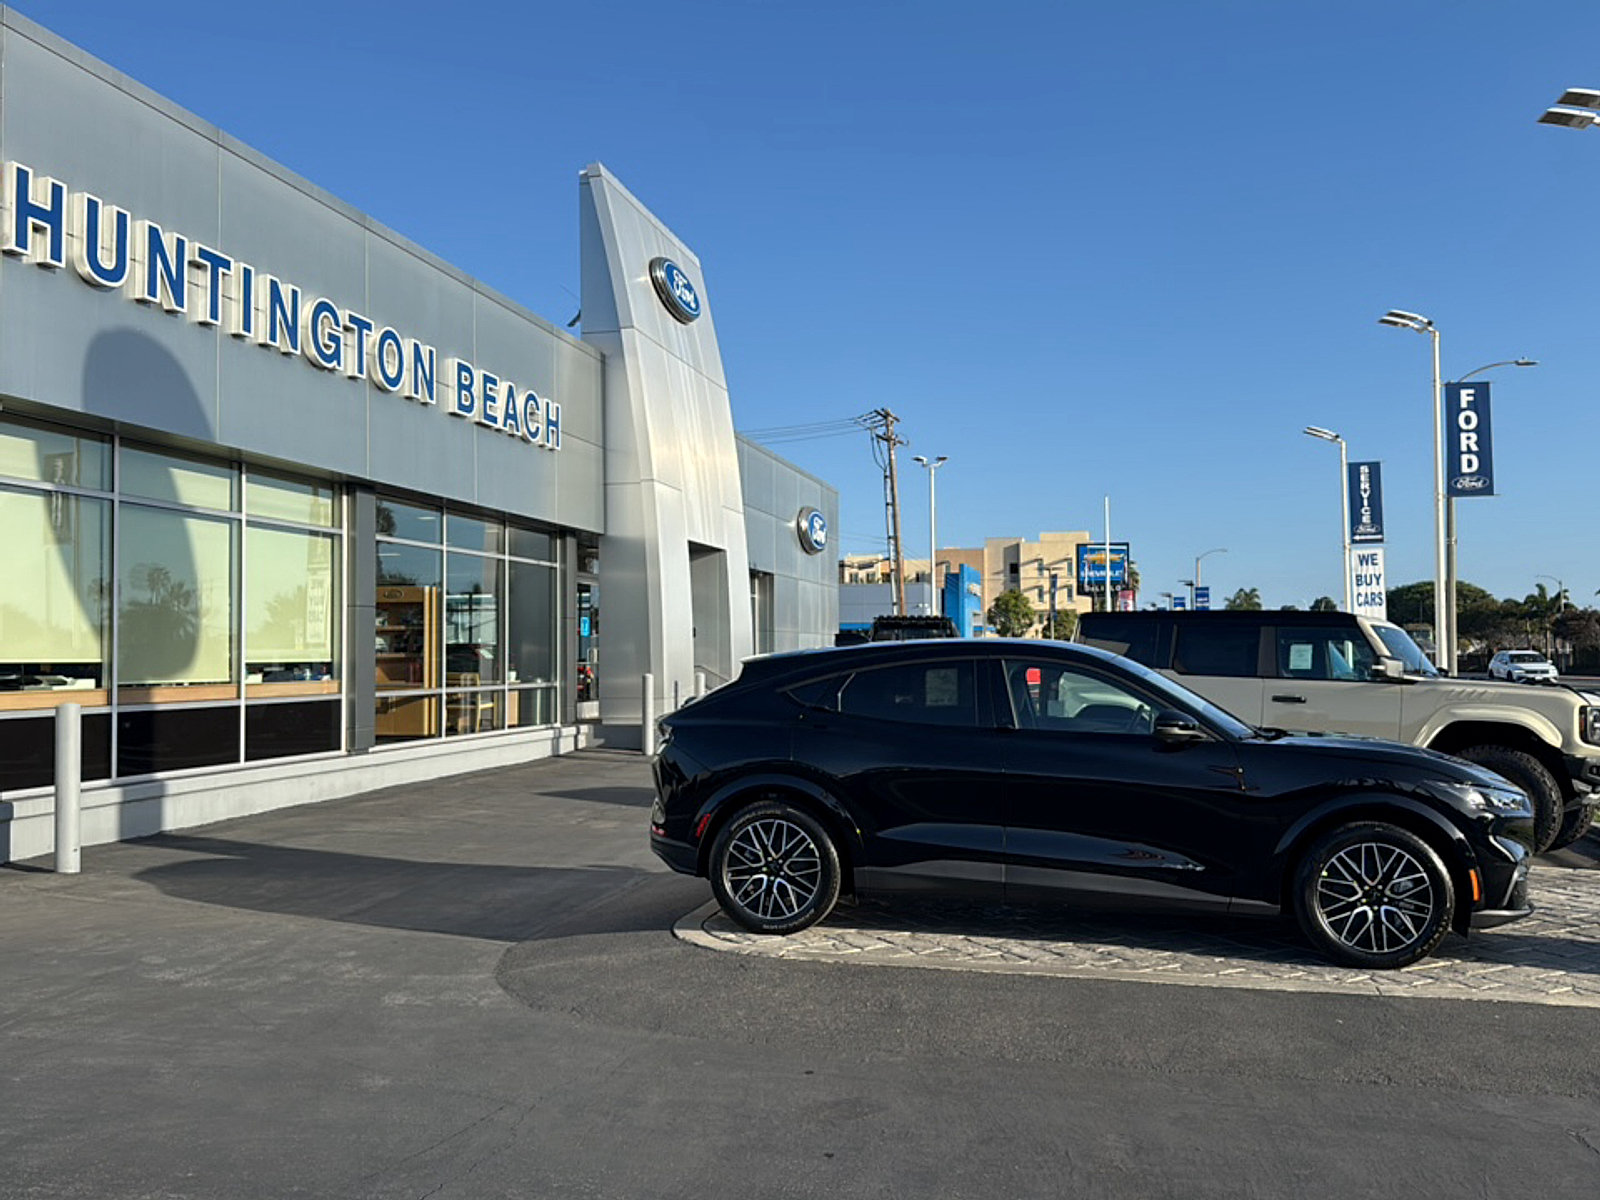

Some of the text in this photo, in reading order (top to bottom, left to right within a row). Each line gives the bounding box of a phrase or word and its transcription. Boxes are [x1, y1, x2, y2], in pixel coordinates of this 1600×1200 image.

[672, 268, 697, 310] Ford
[3, 161, 561, 450] HUNTINGTON BEACH
[1458, 389, 1479, 473] FORD
[1360, 465, 1371, 524] SERVICE
[1457, 476, 1483, 489] Ford
[1358, 553, 1379, 566] WE
[1355, 573, 1382, 587] BUY
[1357, 591, 1384, 607] CARS
